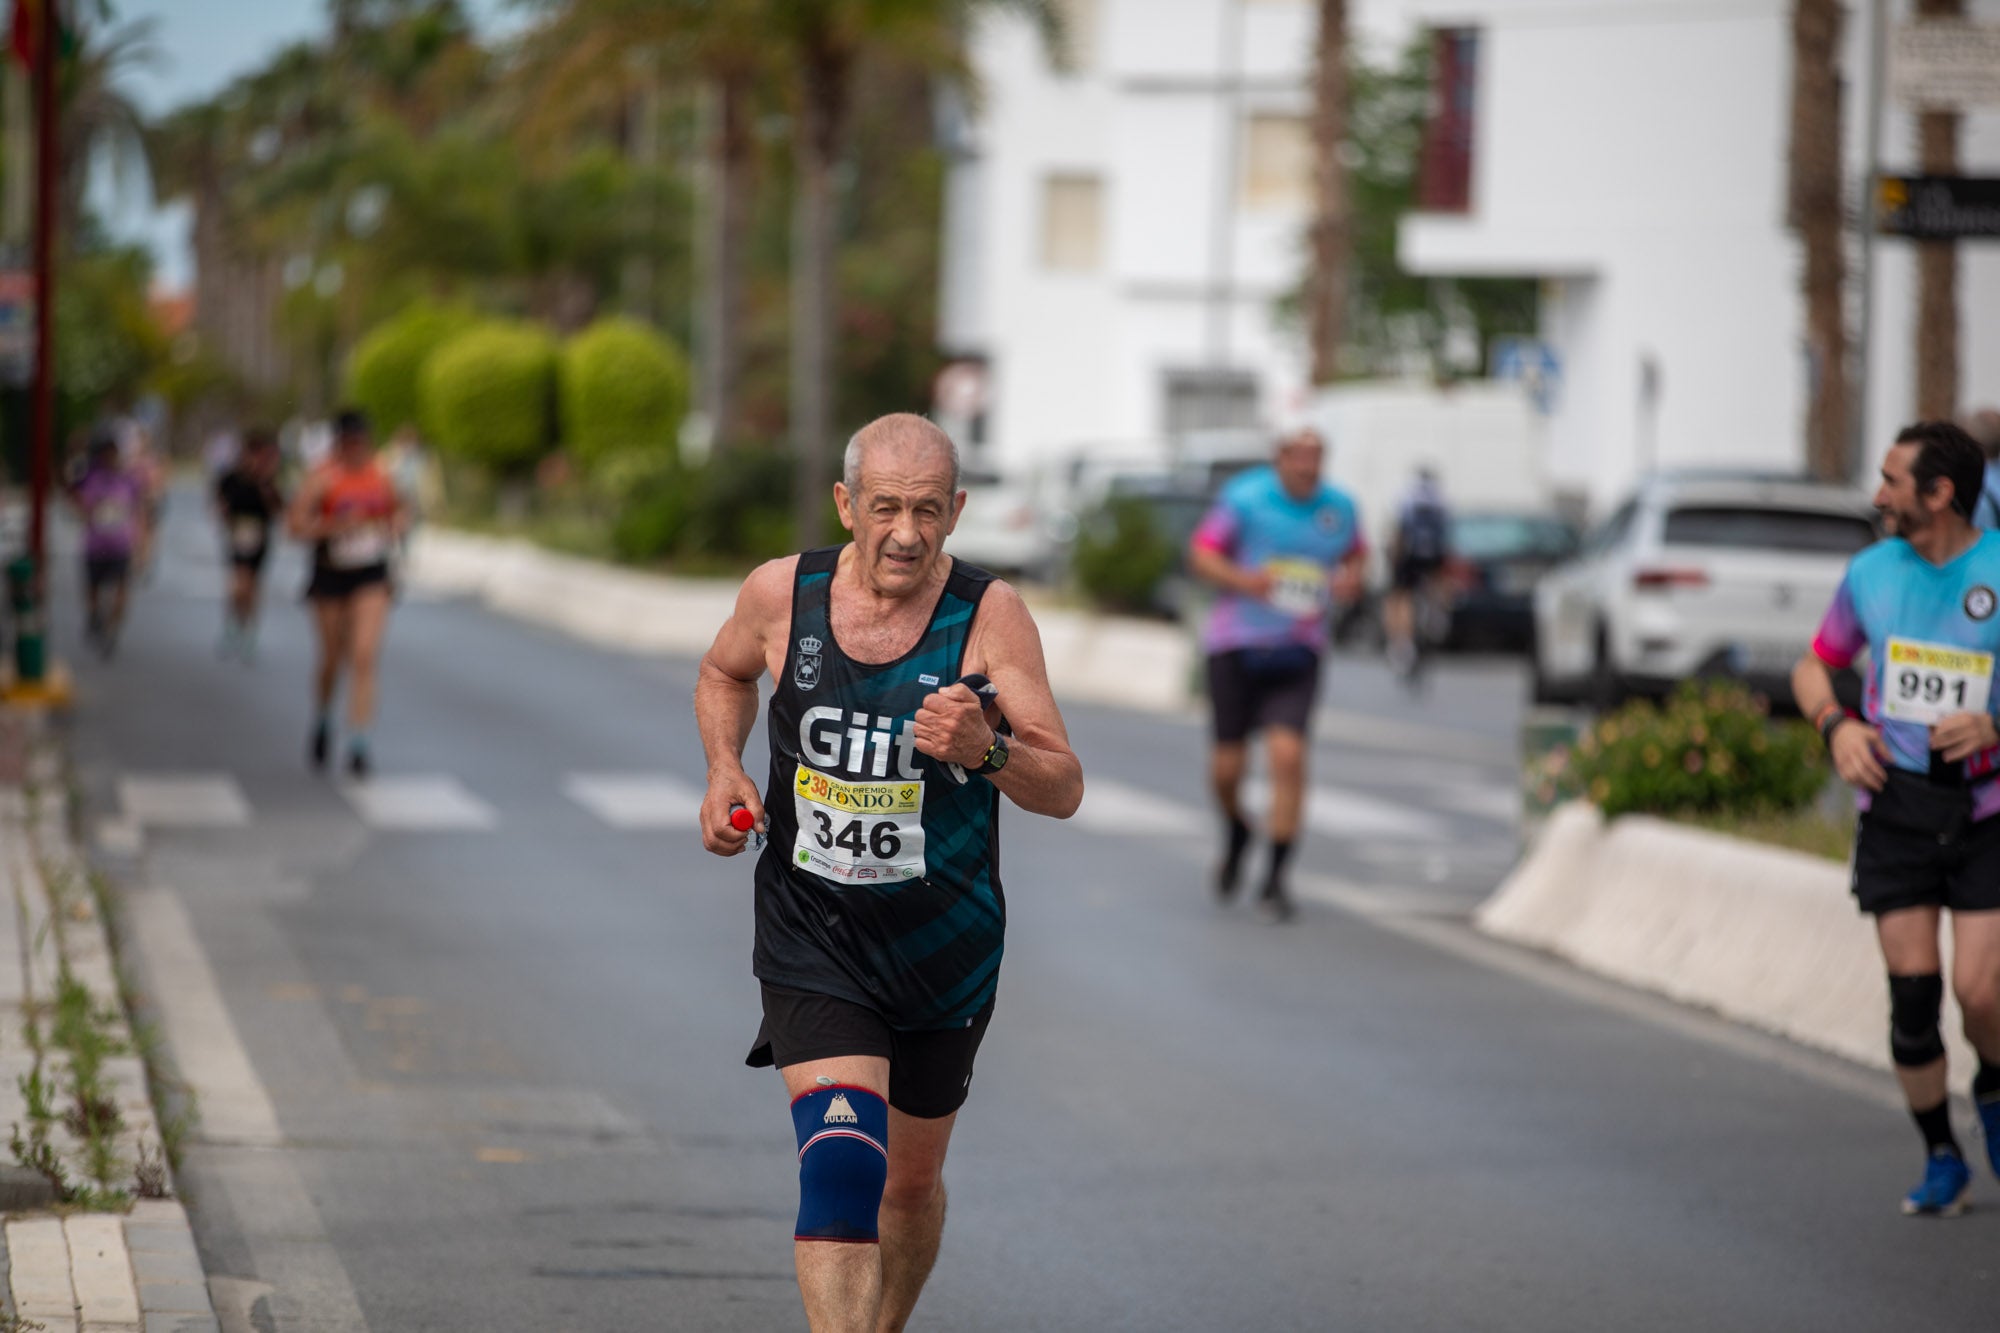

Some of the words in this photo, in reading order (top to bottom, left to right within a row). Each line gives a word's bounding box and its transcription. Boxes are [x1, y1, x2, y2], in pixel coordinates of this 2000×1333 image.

[1900, 669, 1966, 707] 991
[800, 707, 922, 780] Giit
[811, 776, 828, 797] 38
[831, 782, 850, 793] GRAN
[827, 787, 894, 808] FONDO
[813, 810, 901, 860] 346
[824, 1115, 857, 1124] VULKAN
